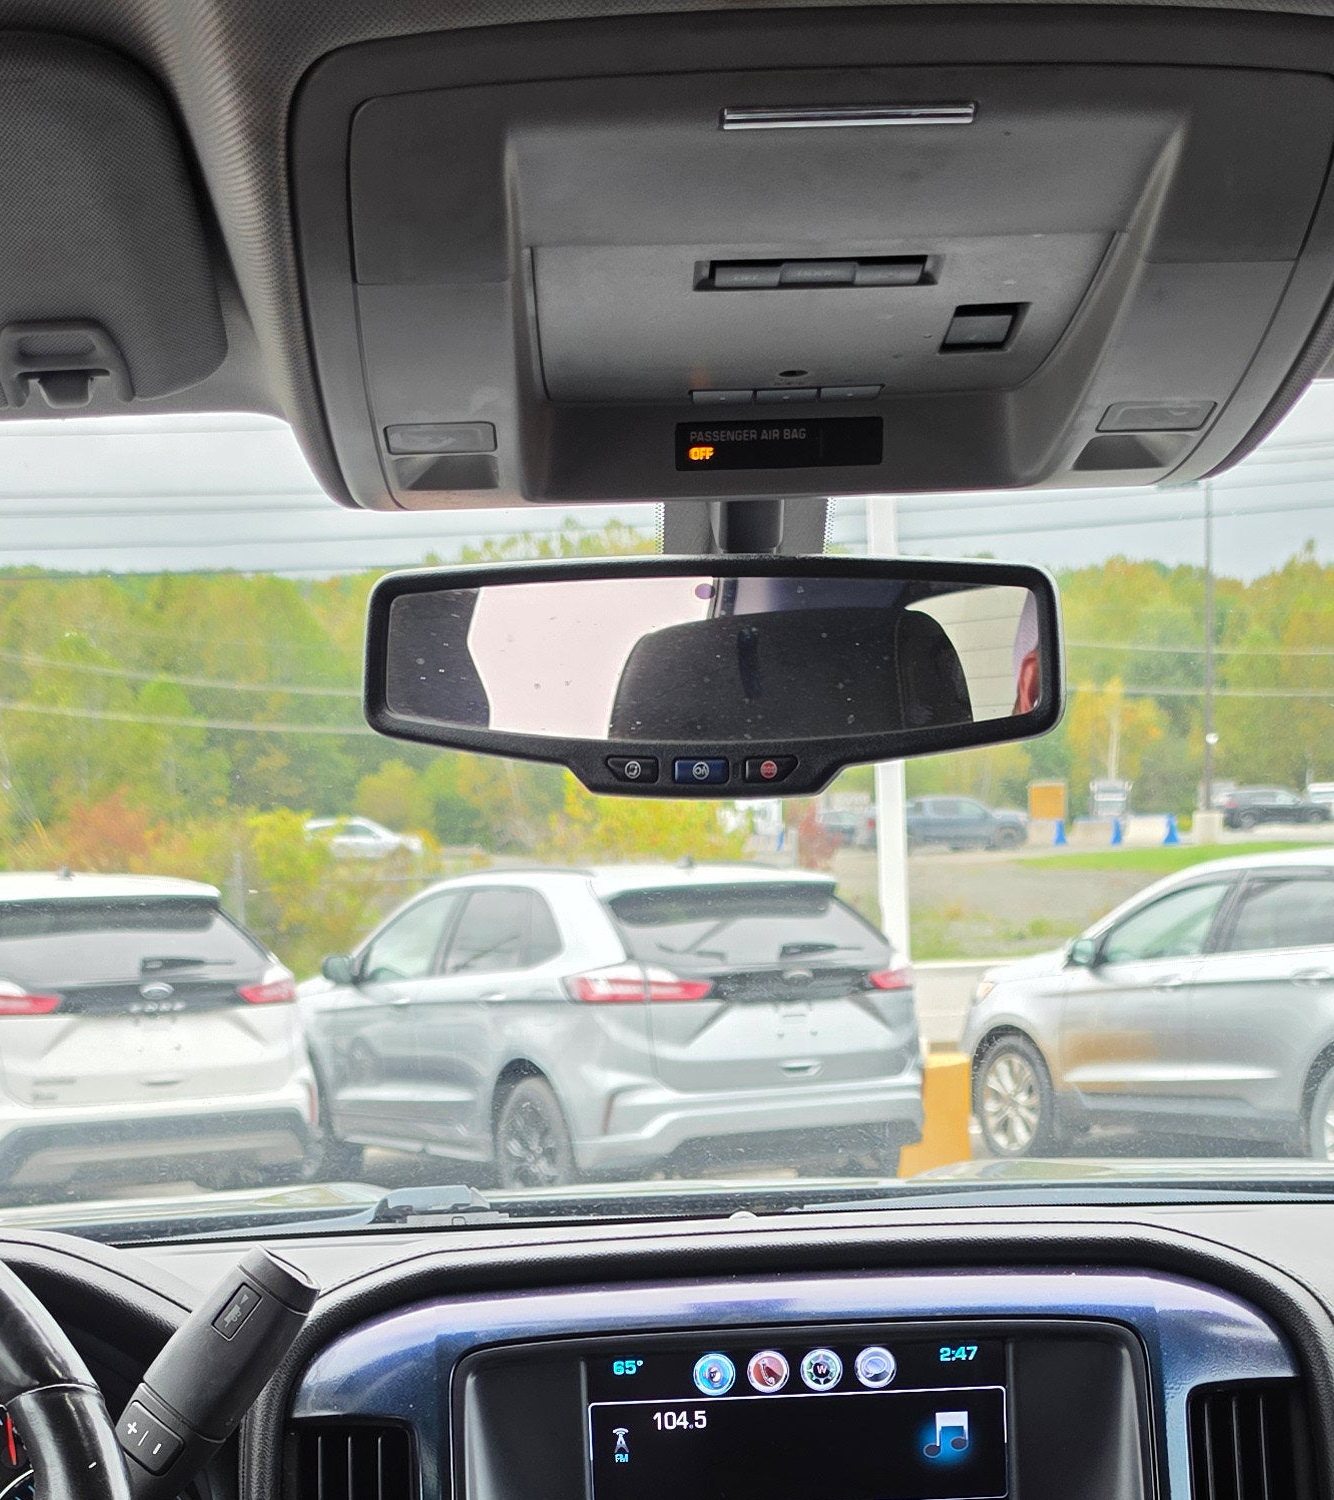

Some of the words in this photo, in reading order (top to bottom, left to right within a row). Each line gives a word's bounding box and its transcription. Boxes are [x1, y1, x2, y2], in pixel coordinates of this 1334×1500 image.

[690, 430, 757, 442] PASSENGER
[761, 429, 779, 440] AIR
[783, 428, 806, 440] BAG
[689, 447, 714, 460] OFF
[939, 1346, 978, 1362] 2:47
[613, 1360, 644, 1375] 65°
[653, 1411, 706, 1430] 104.5
